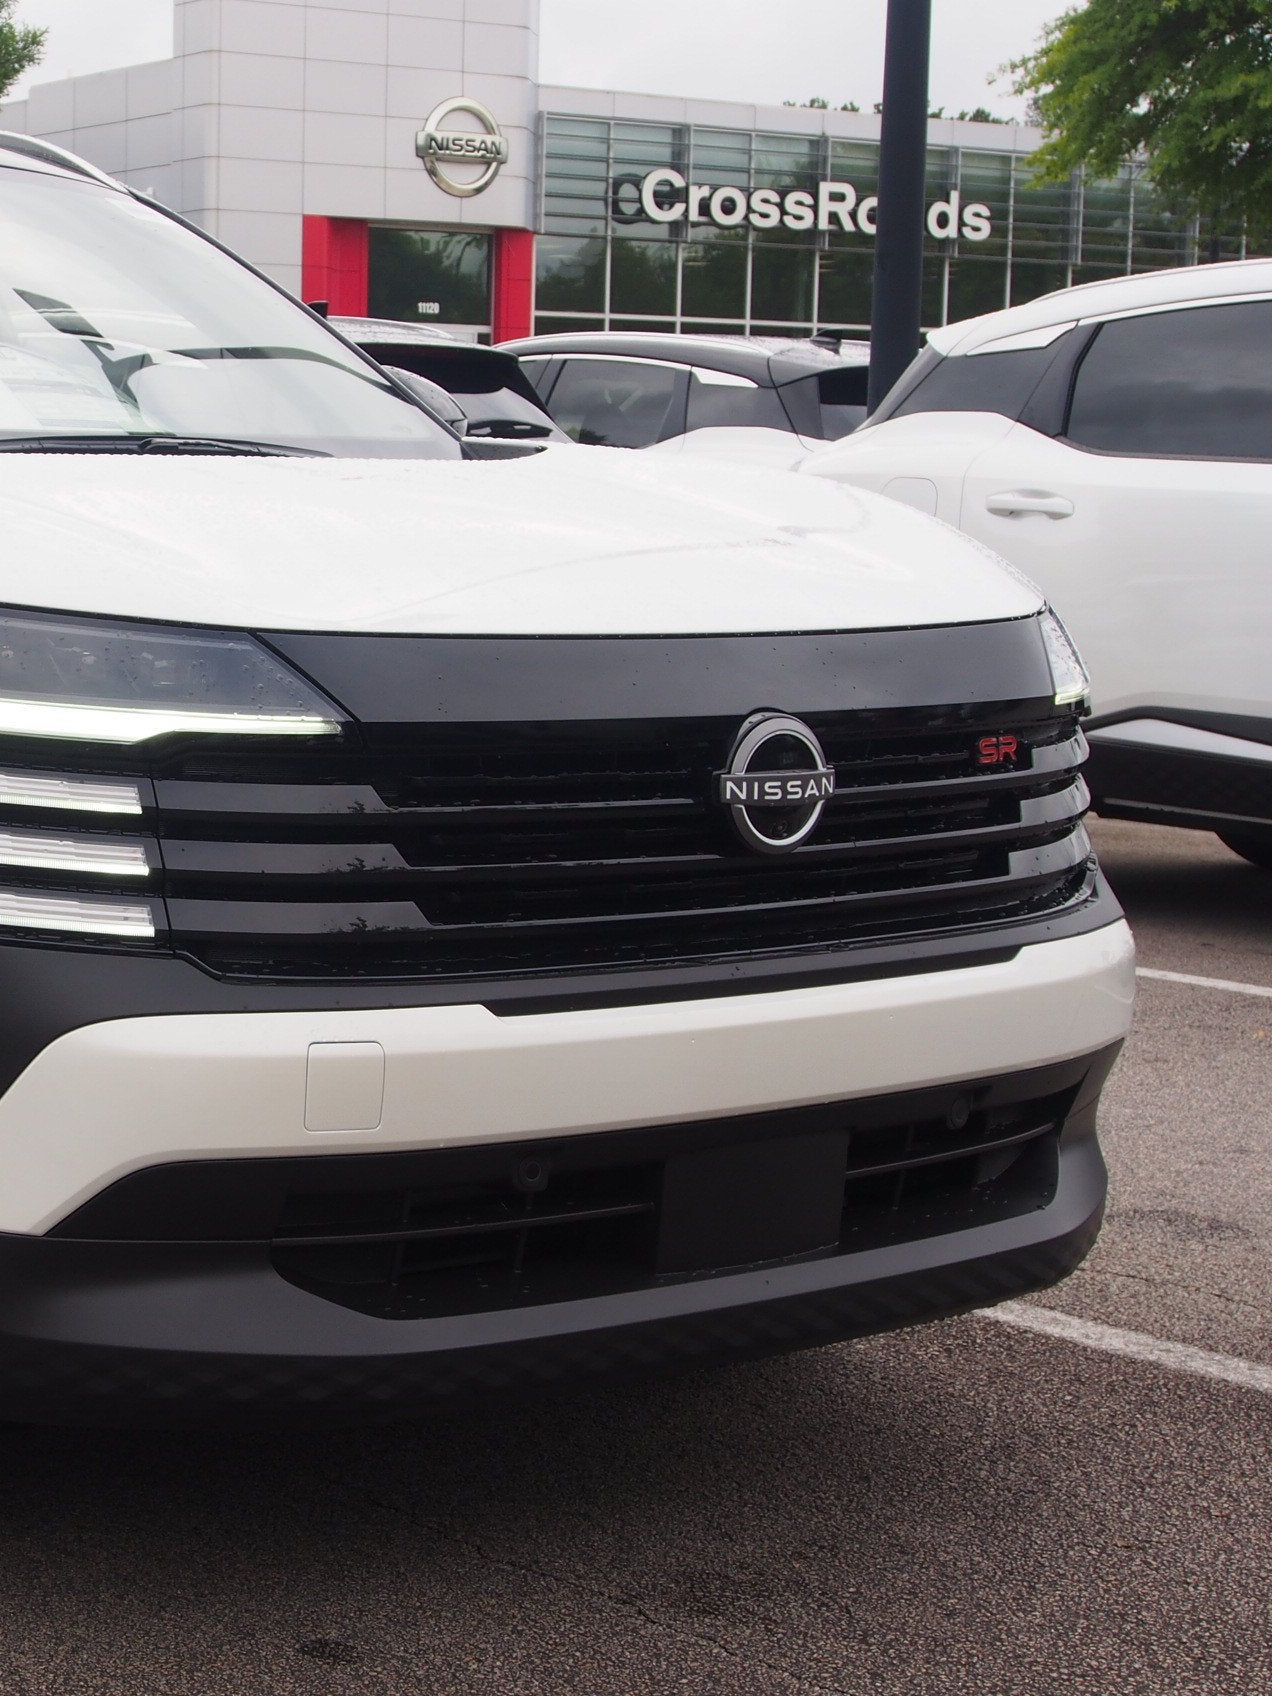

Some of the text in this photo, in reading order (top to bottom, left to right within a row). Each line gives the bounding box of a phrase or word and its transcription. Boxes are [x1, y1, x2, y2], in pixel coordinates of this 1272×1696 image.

[428, 135, 502, 156] NISSAN
[640, 167, 992, 242] CrossRods
[418, 302, 440, 314] 11120
[978, 735, 1018, 764] SR
[726, 775, 835, 800] NISSAN
